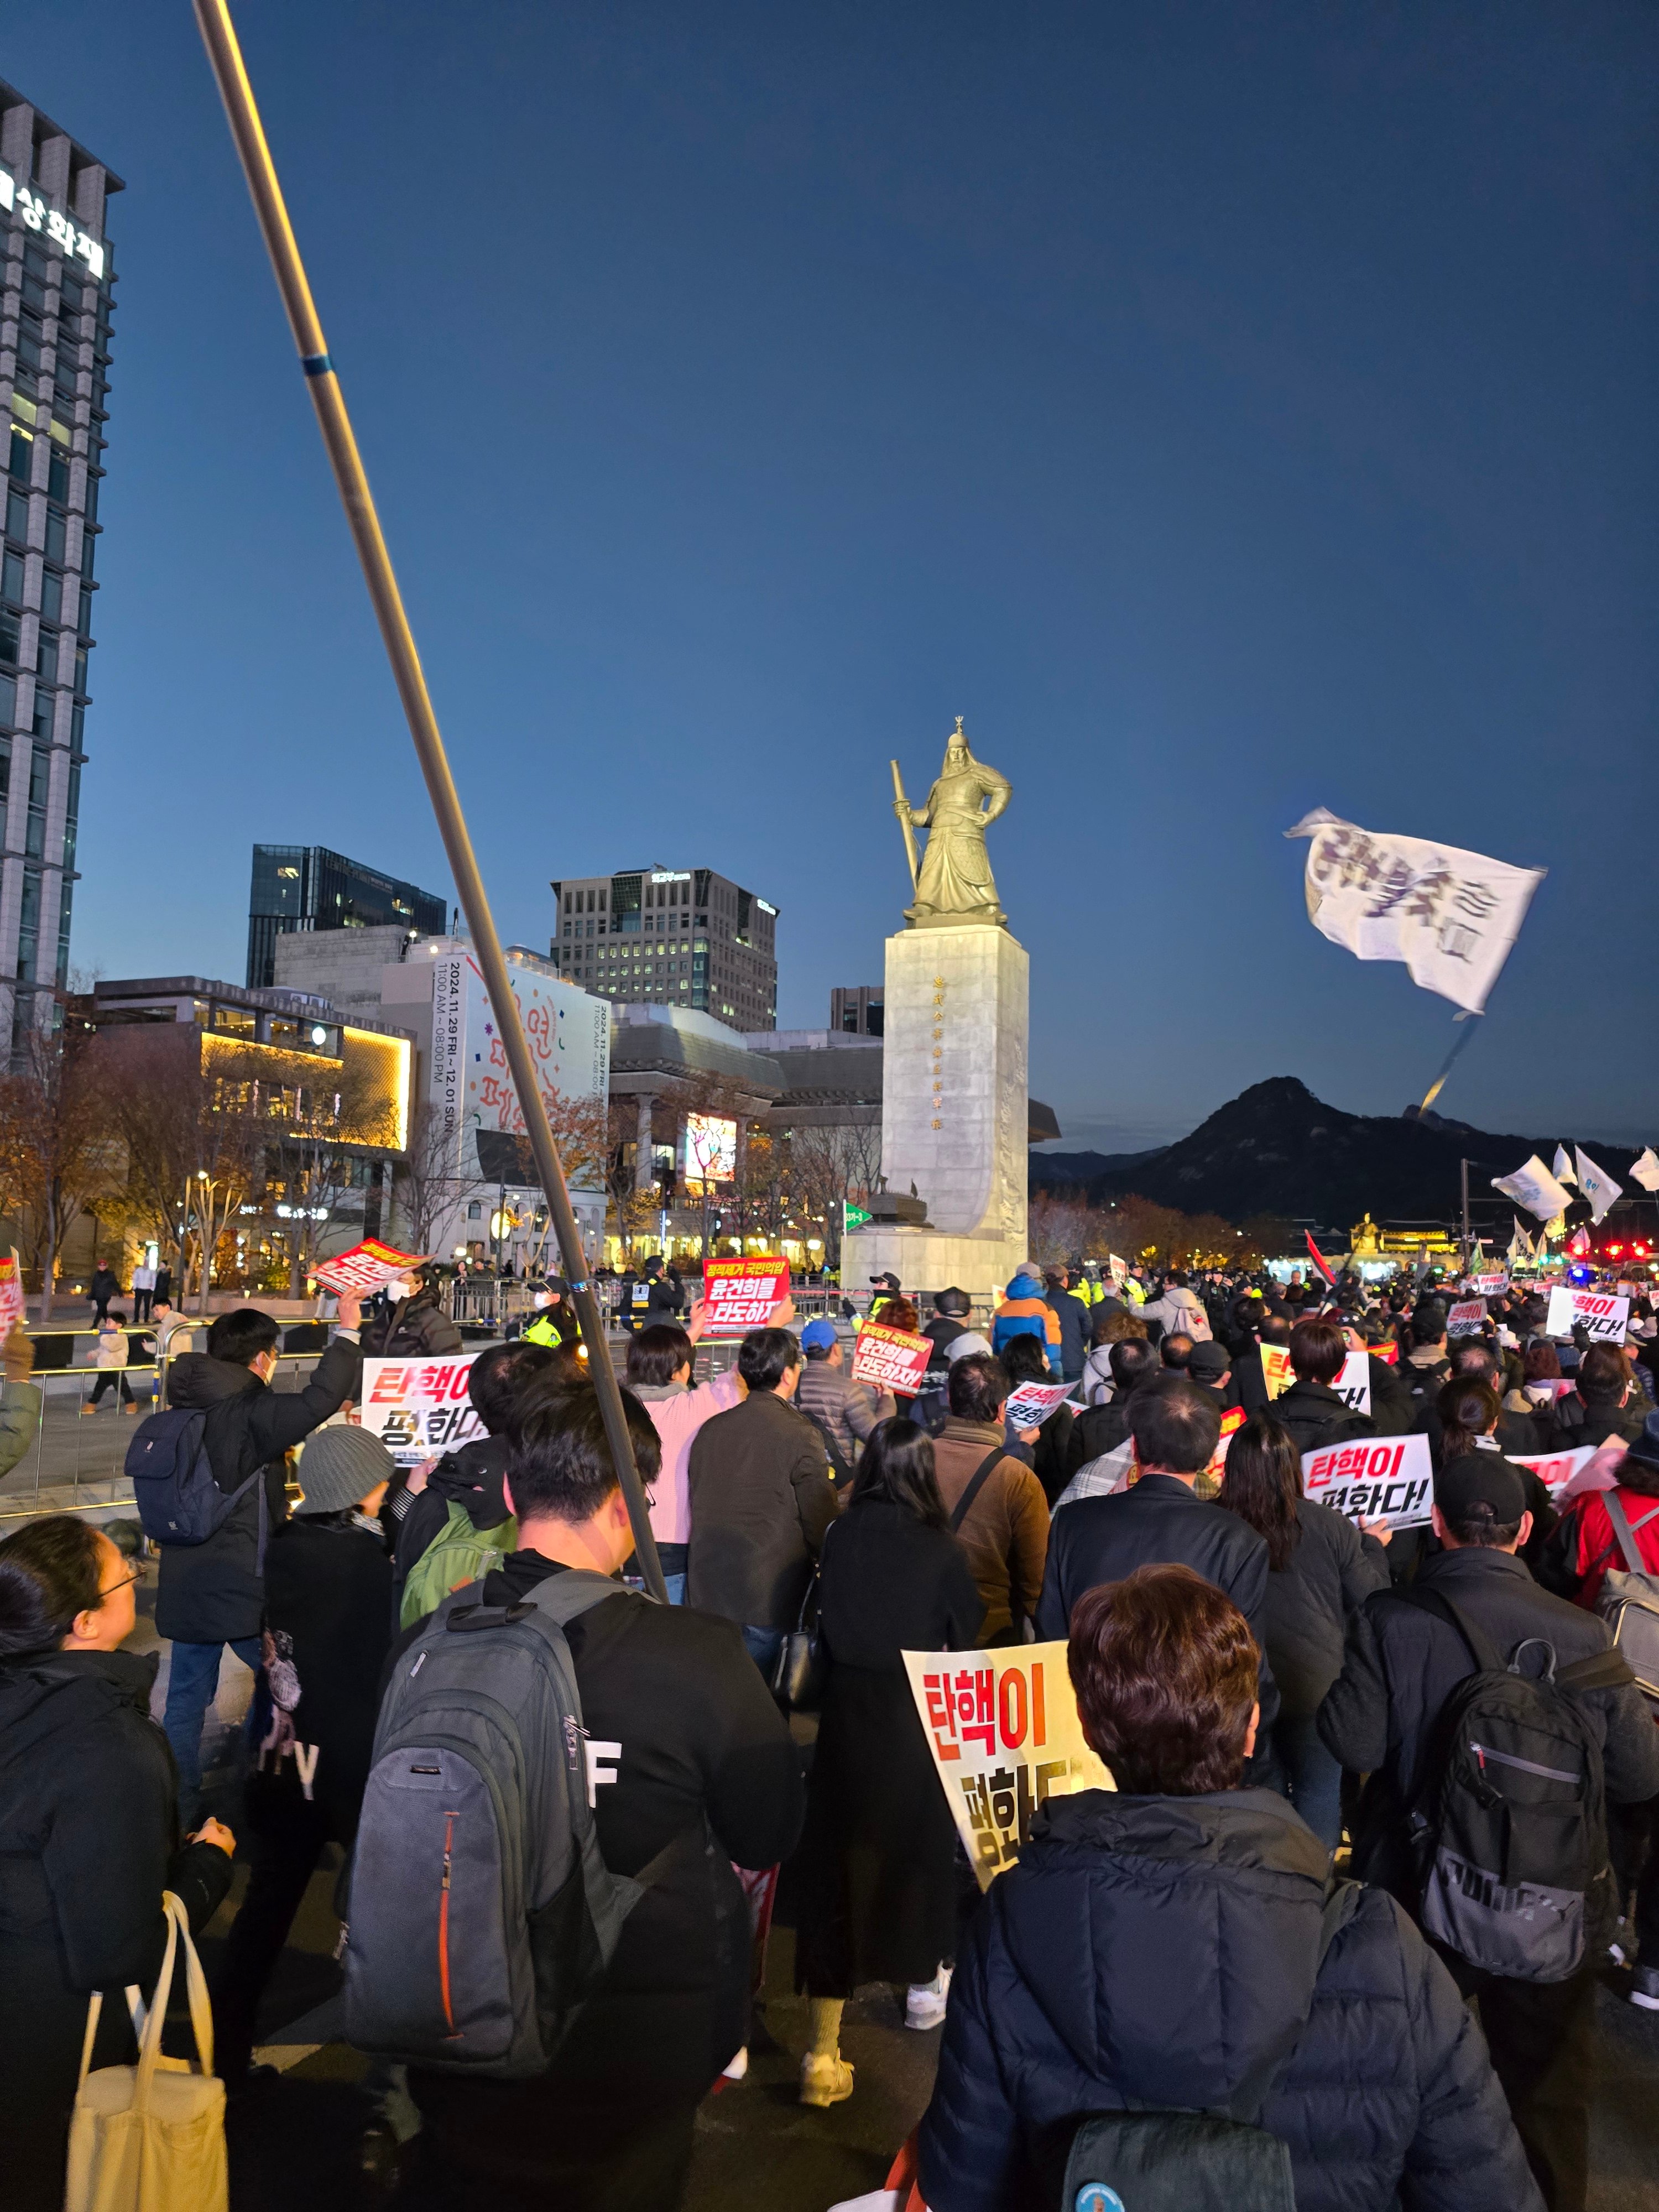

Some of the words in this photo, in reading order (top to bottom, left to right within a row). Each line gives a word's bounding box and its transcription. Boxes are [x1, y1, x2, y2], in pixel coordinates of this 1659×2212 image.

[437, 963, 447, 992] 11:00
[436, 995, 446, 1014] AM
[435, 1027, 445, 1061] 08:00
[447, 1036, 457, 1055] FRI
[593, 1031, 599, 1048] AM
[434, 1065, 444, 1083] PM
[444, 1107, 455, 1134] SUN
[707, 1263, 745, 1277] 정적제거
[746, 1261, 786, 1276] 국민억압
[709, 1277, 777, 1300] 윤건희를
[1449, 1303, 1482, 1322] 탄핵이
[1572, 1295, 1616, 1316] 핵이
[1572, 1314, 1625, 1336] 화다!
[1307, 1443, 1406, 1489] 탄핵이
[1321, 1477, 1431, 1517] 평화다!
[923, 1662, 1046, 1761] 탄핵이
